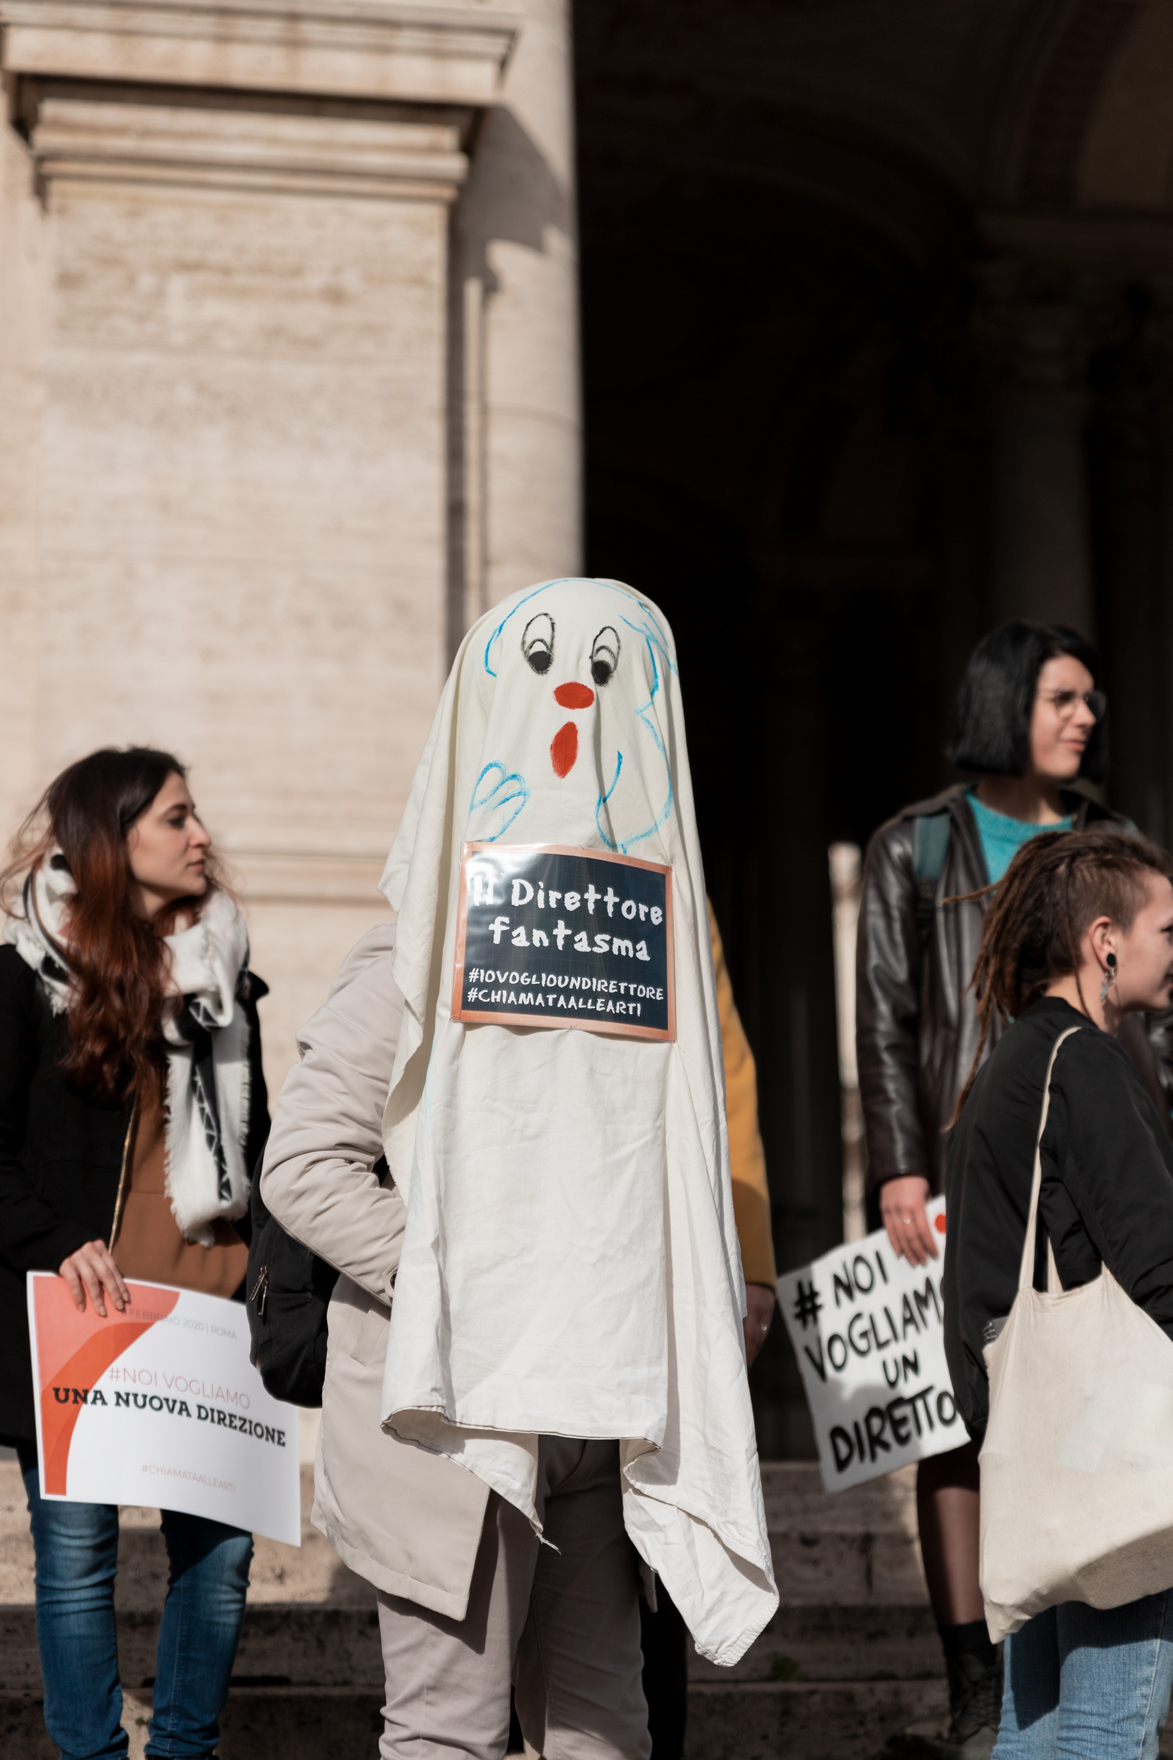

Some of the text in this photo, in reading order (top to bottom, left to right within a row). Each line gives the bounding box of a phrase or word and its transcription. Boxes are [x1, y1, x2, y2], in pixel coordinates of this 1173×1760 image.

[511, 879, 663, 925] Direttore
[488, 917, 650, 961] fantasma
[467, 988, 641, 1017] #CHIAMATAALLEARTI
[468, 968, 664, 1001] #IOVOGLIOUNDIRETTORE
[129, 1308, 180, 1327] FEBBRAIO
[182, 1318, 204, 1332] 2020
[210, 1325, 238, 1341] ROMA
[804, 1276, 945, 1382] VOGLIAM
[108, 1366, 251, 1410] #NOI VOGLIAMO
[882, 1348, 921, 1389] UN
[52, 1387, 286, 1448] UNA NUOVA DIREZIONE
[142, 1464, 236, 1493] #CHIAMATAALLEARTI
